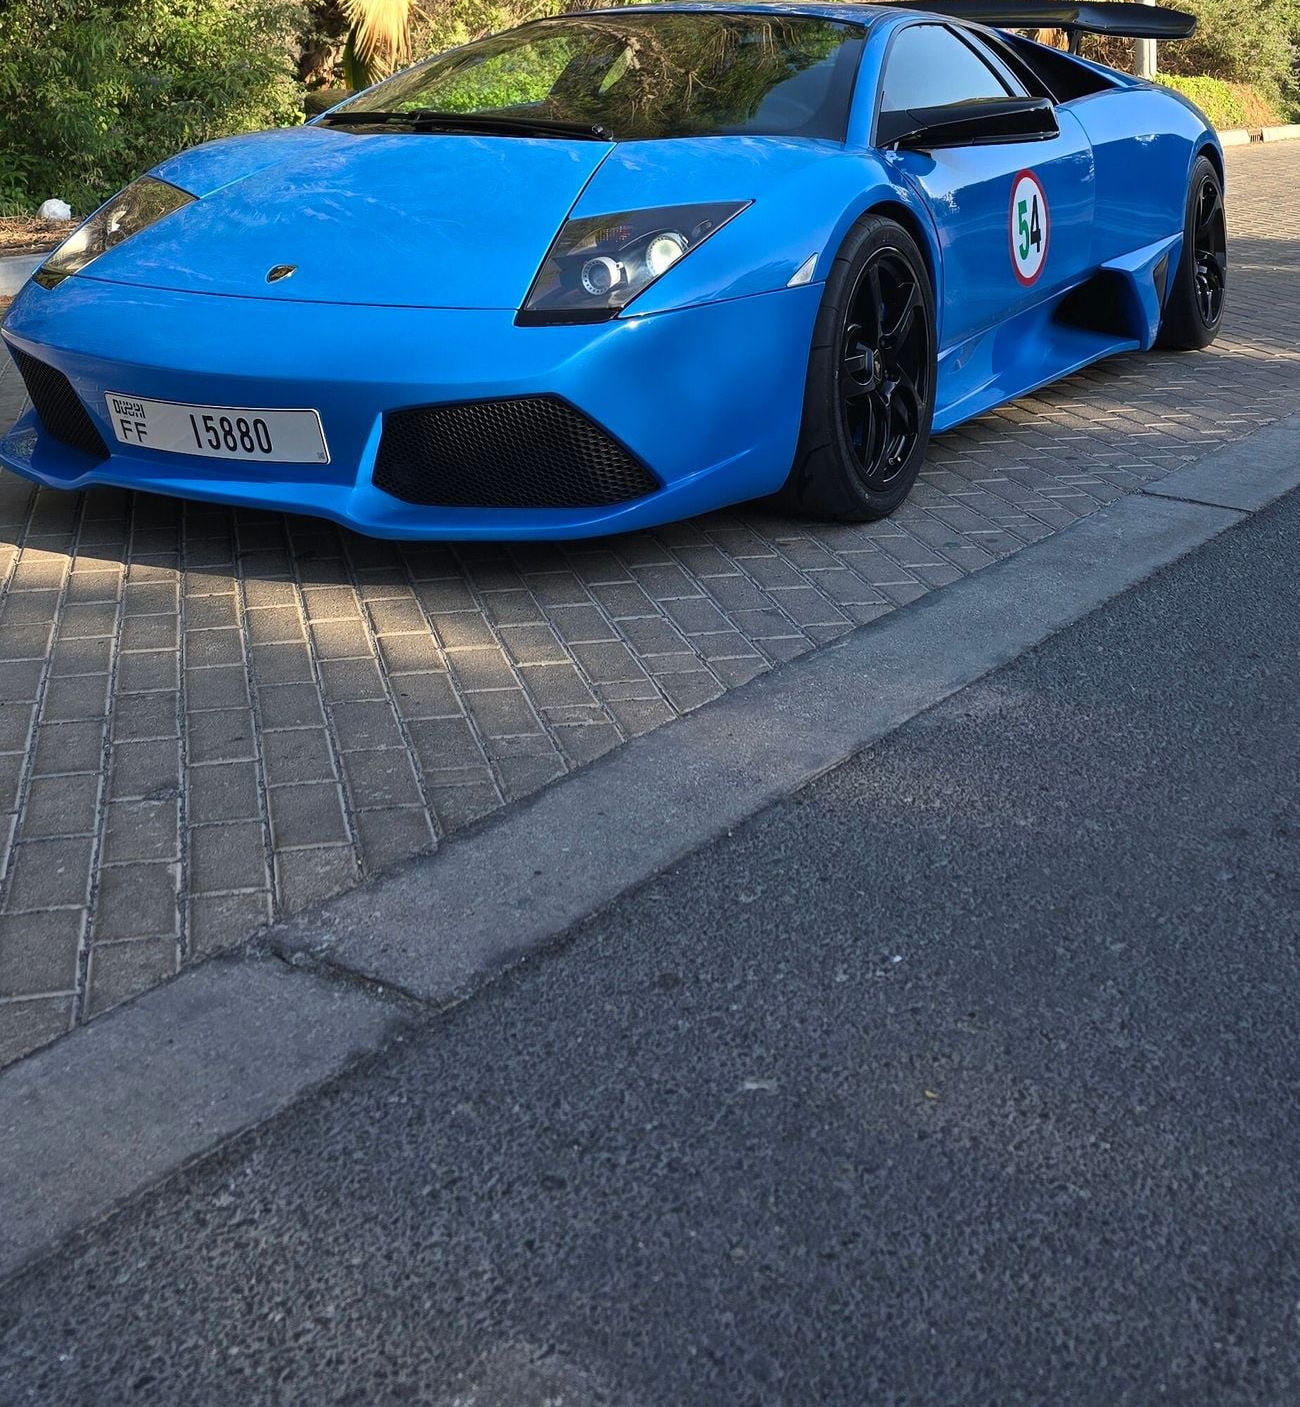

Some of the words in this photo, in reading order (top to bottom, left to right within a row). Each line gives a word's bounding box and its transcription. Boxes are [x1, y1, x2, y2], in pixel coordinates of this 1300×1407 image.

[1018, 194, 1041, 260] 54
[120, 418, 148, 442] FF
[189, 414, 273, 454] 15880
